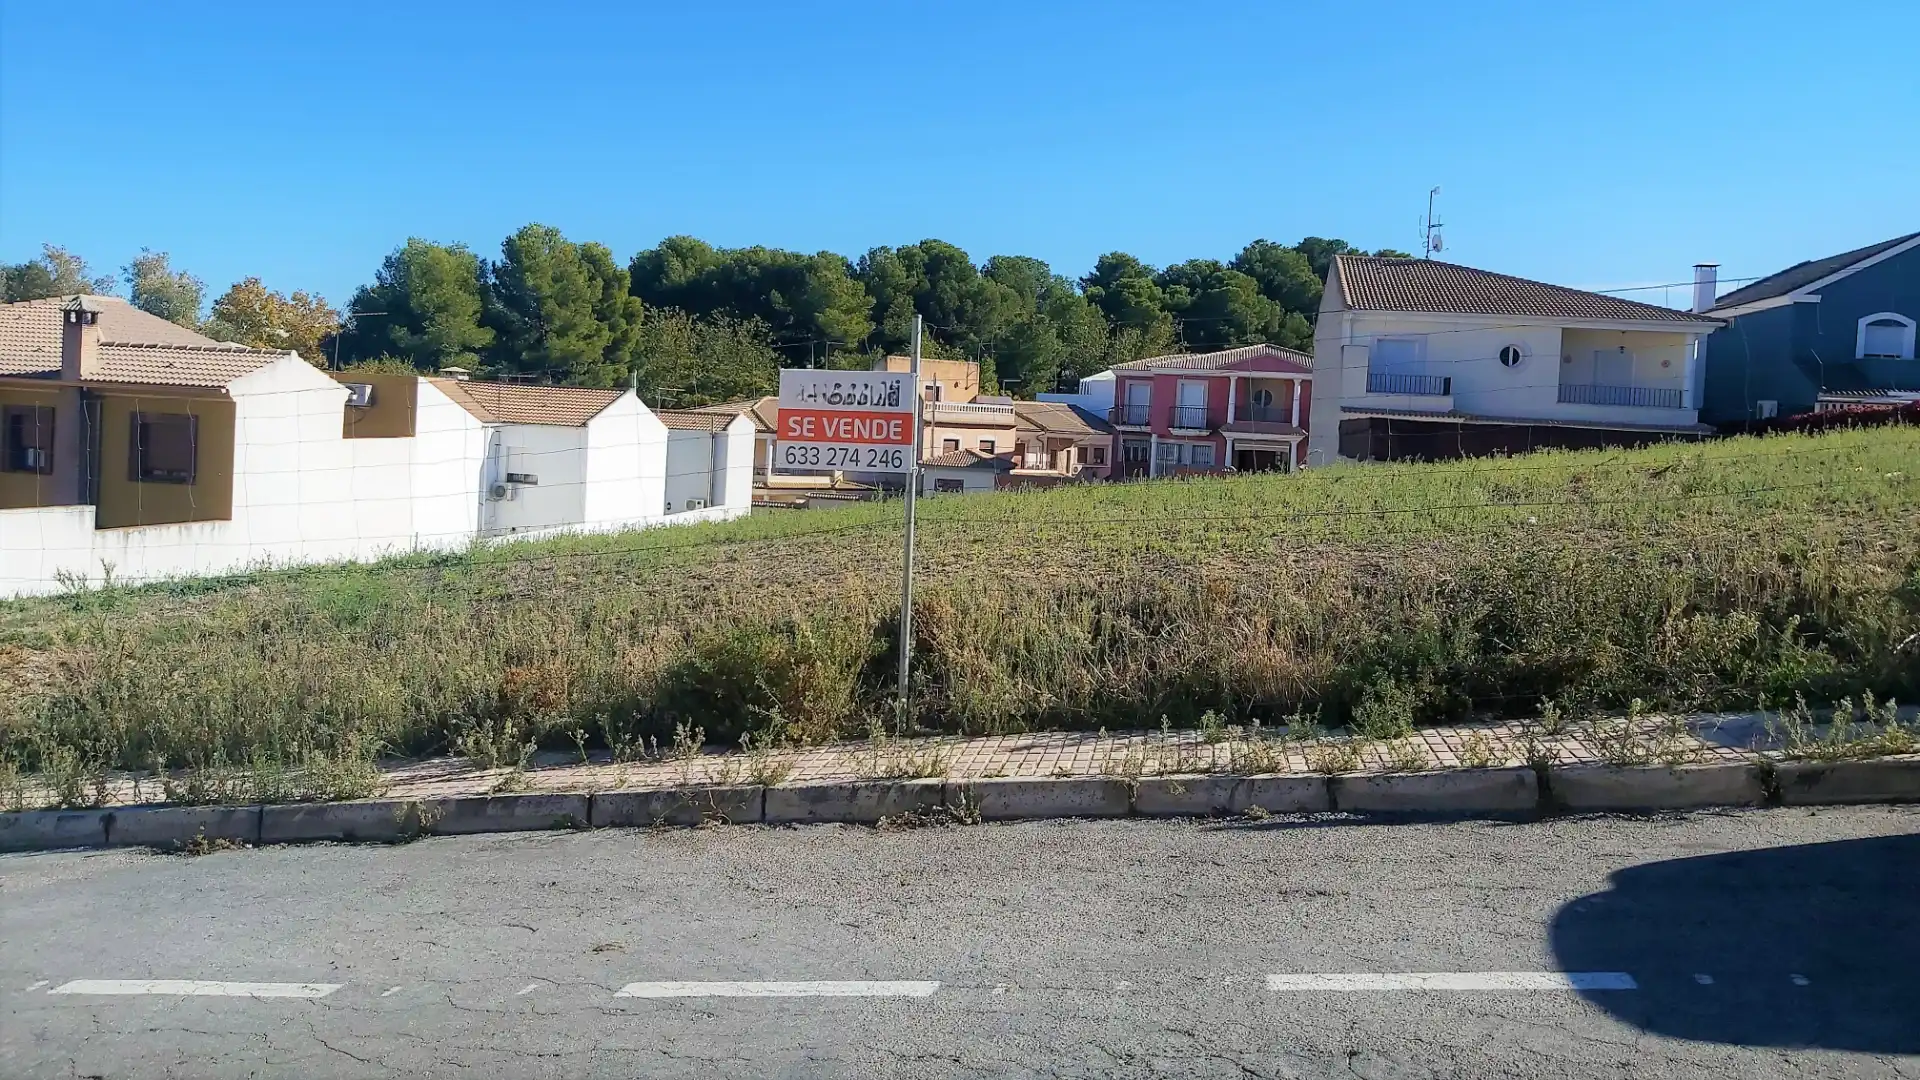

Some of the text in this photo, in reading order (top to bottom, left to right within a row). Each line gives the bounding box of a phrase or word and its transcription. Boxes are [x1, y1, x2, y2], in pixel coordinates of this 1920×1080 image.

[788, 416, 903, 440] SE VENDE
[785, 446, 903, 469] 633 274 246
